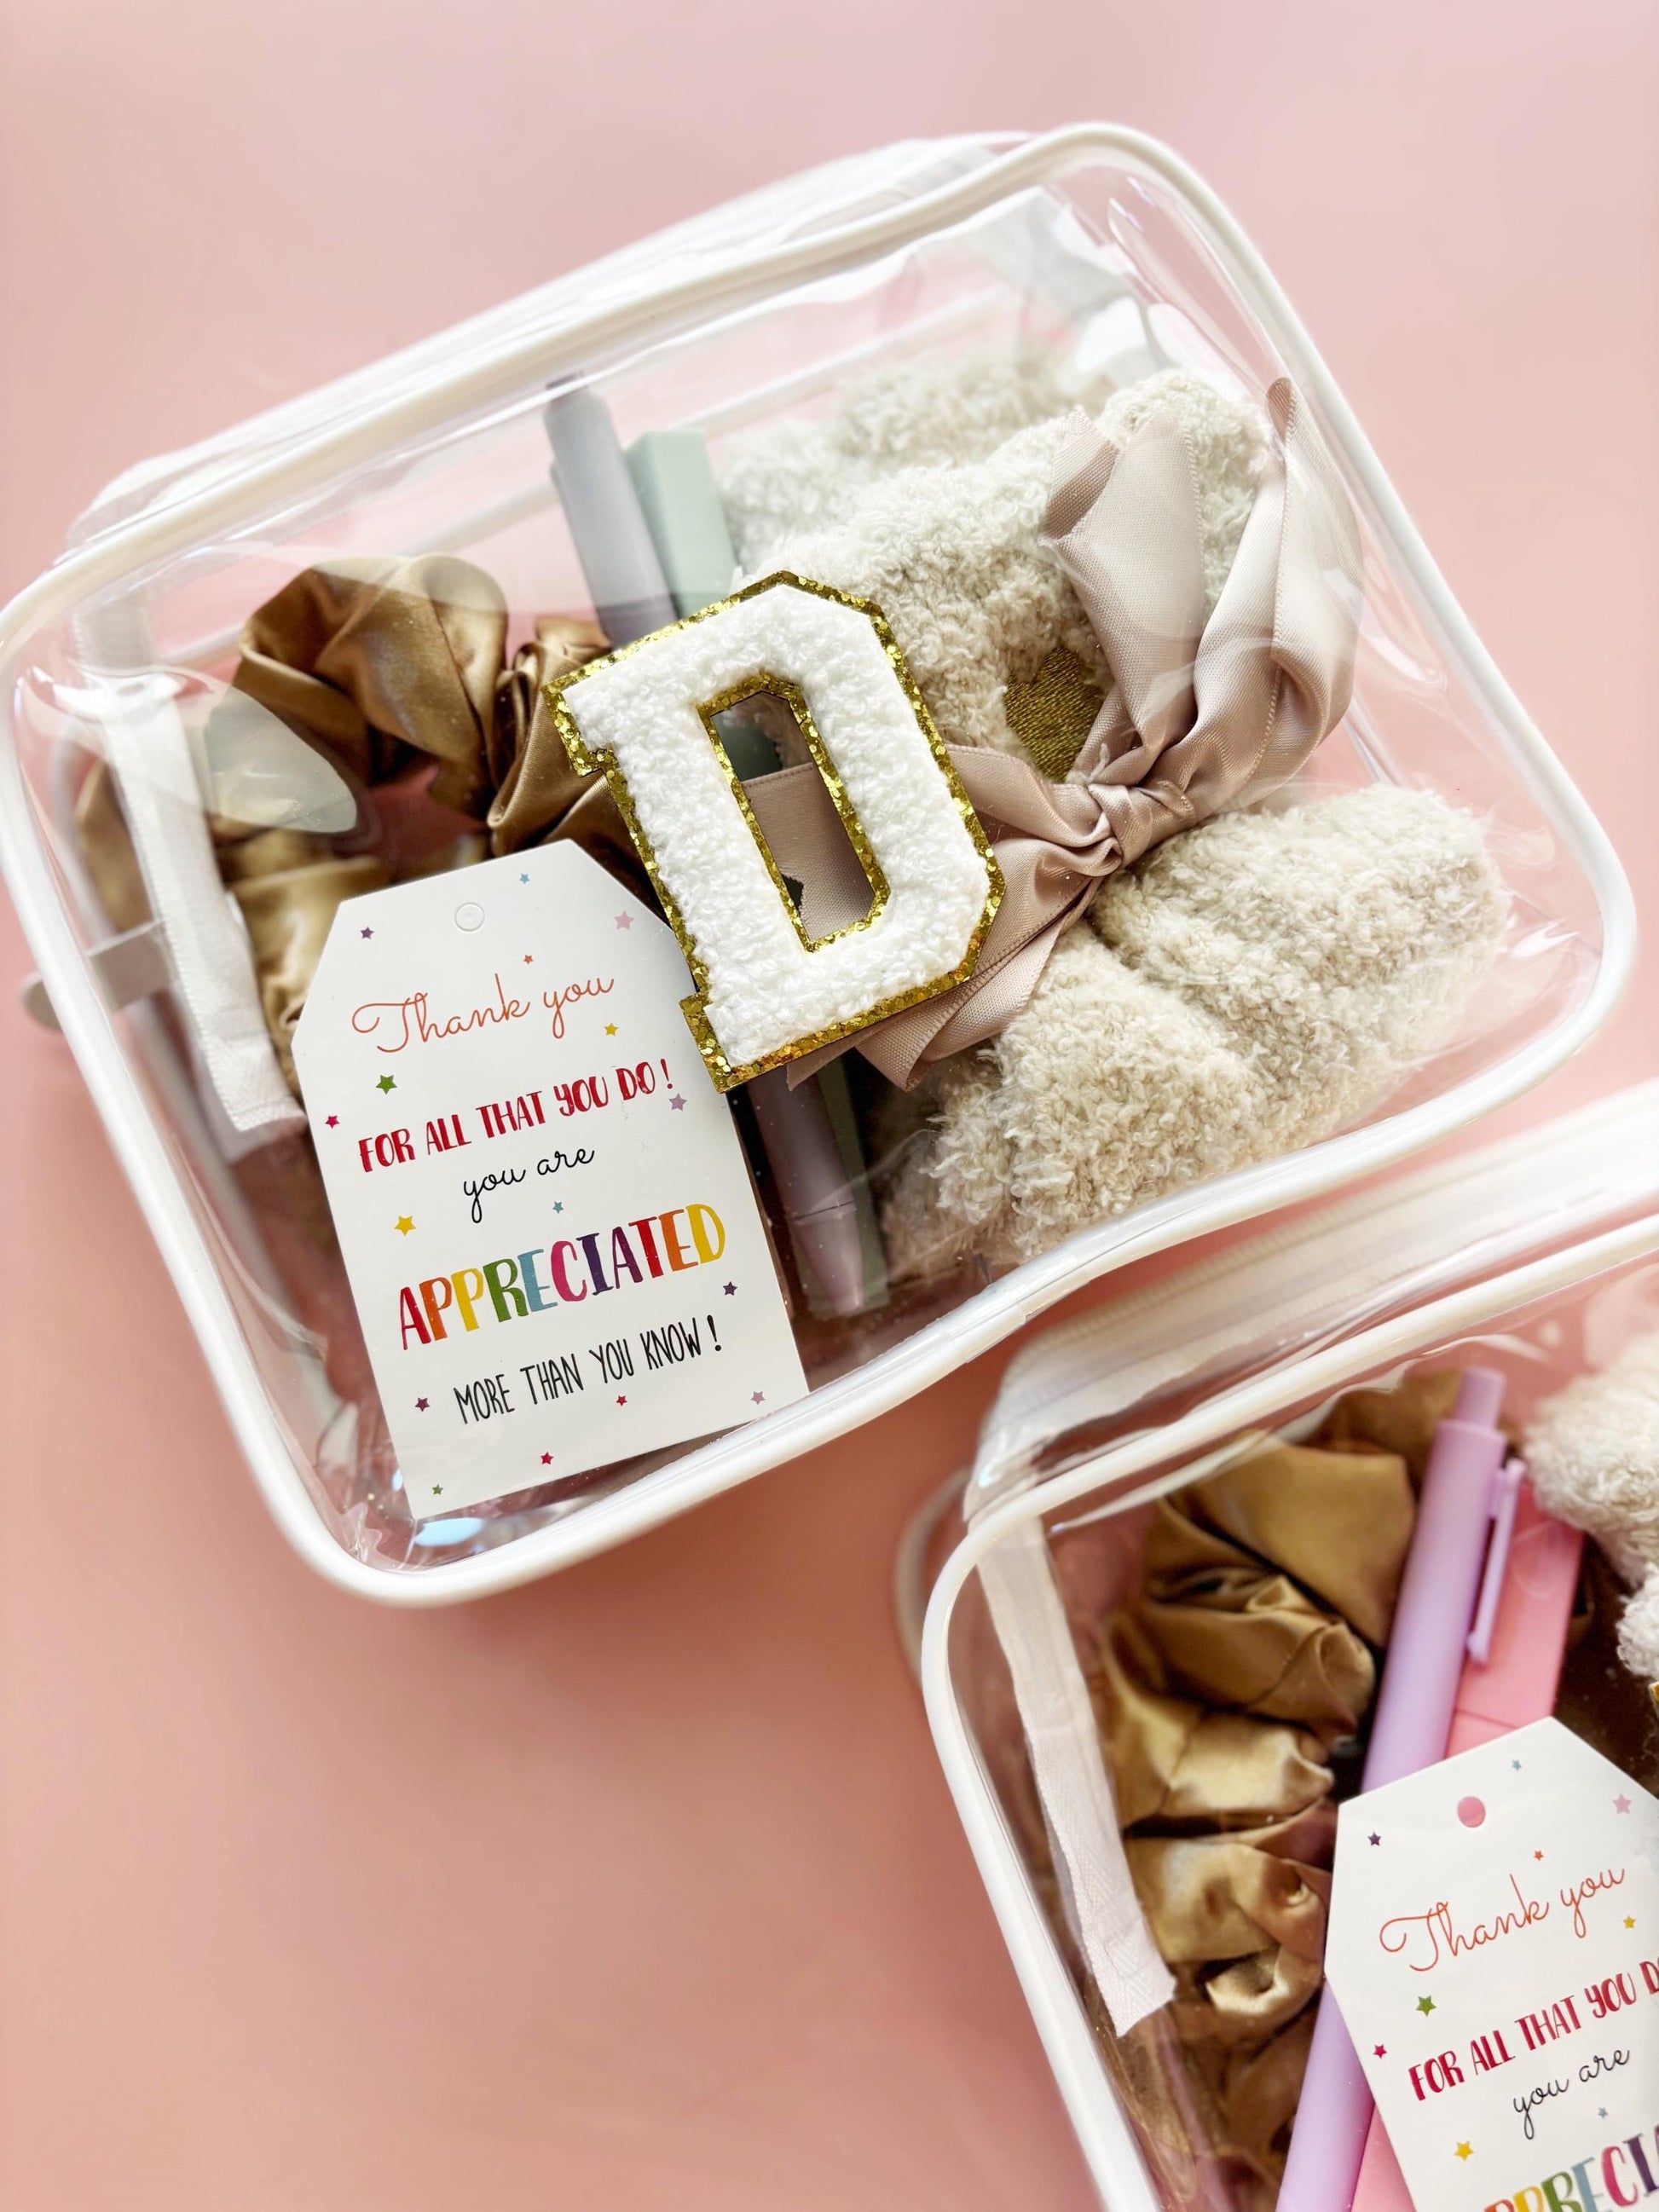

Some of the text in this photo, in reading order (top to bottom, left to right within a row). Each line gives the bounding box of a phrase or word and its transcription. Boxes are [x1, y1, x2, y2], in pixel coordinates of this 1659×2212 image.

[541, 570, 1006, 1094] D
[352, 973, 614, 1053] Thank you
[358, 1129, 414, 1172] FOR
[426, 1114, 472, 1154] ALL
[476, 1092, 545, 1139] THAT
[554, 1076, 609, 1118] YOU
[463, 1146, 595, 1223] you are
[400, 1204, 726, 1349] APPRECIATED
[454, 1374, 515, 1424] MORE
[520, 1352, 584, 1404] THAN
[589, 1337, 635, 1384] YOU
[1379, 1868, 1625, 1971] Thank you
[1408, 1955, 1659, 2100] FOR ALL THAT YOU D
[1513, 2050, 1630, 2140] you are
